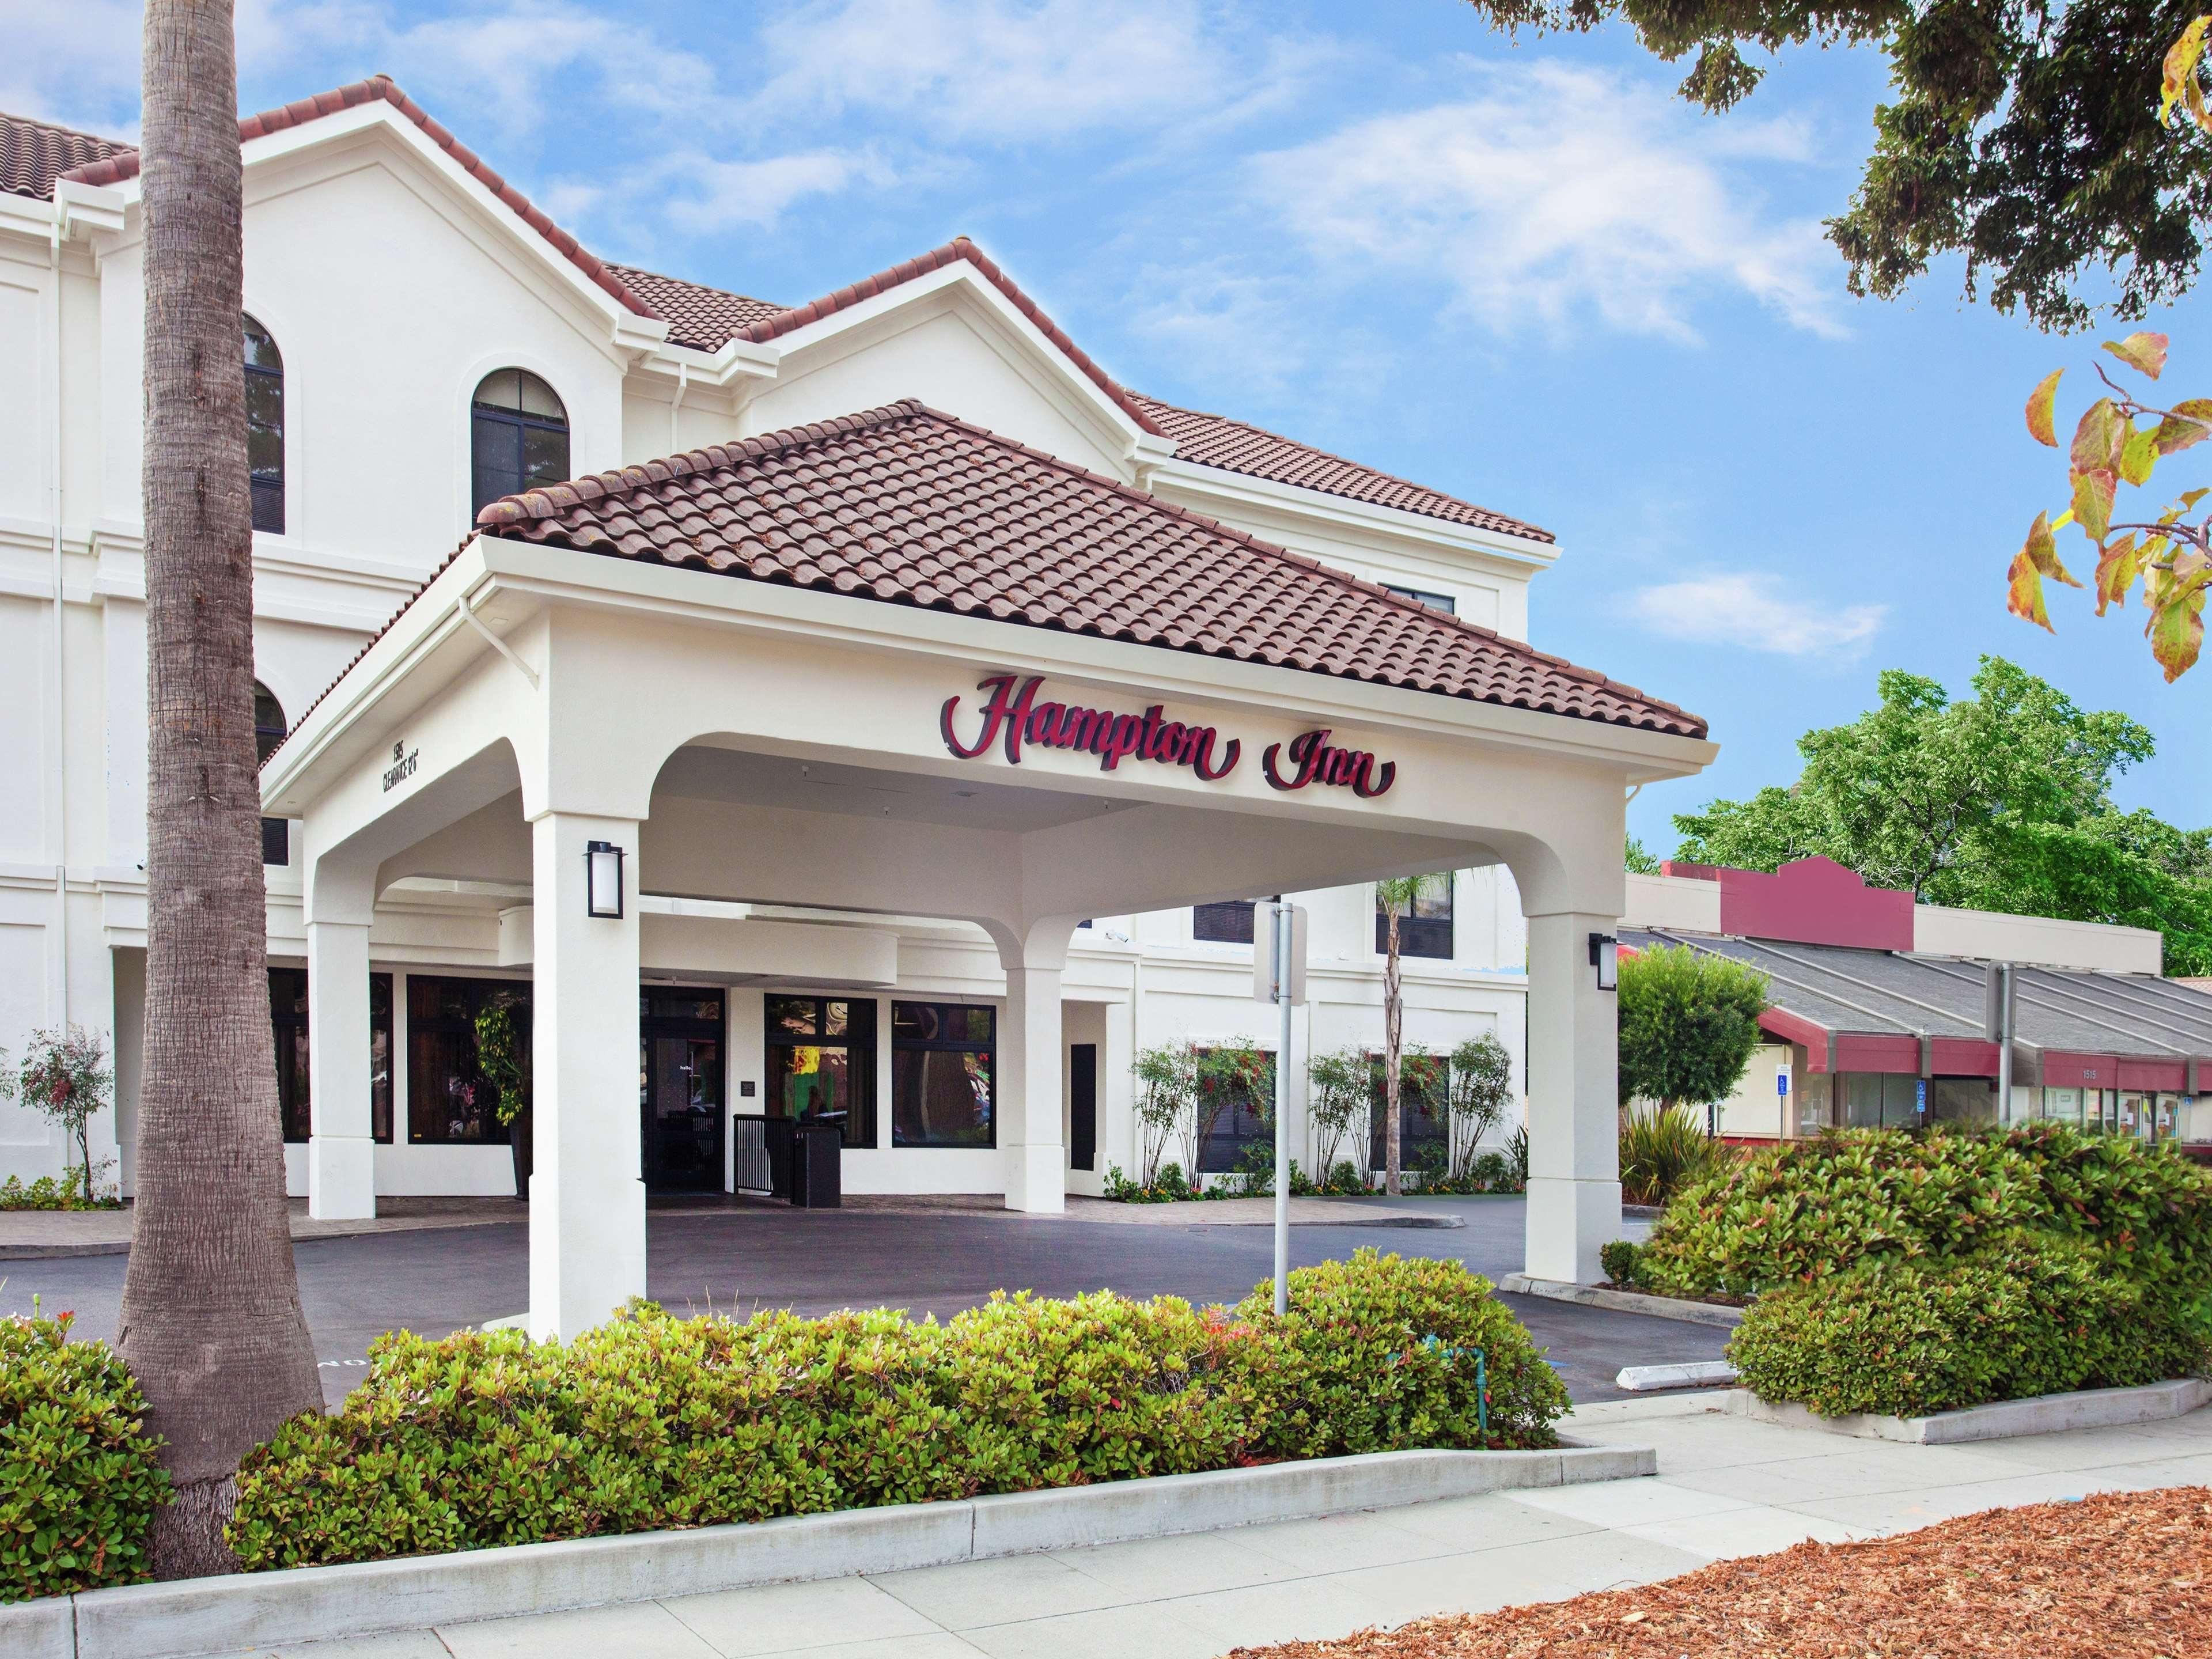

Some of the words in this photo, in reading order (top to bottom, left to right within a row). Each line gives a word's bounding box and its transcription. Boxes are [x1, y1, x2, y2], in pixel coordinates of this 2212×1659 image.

[940, 675, 1240, 781] Hampton
[1262, 729, 1396, 798] Inn
[2083, 1070, 2096, 1080] 1515
